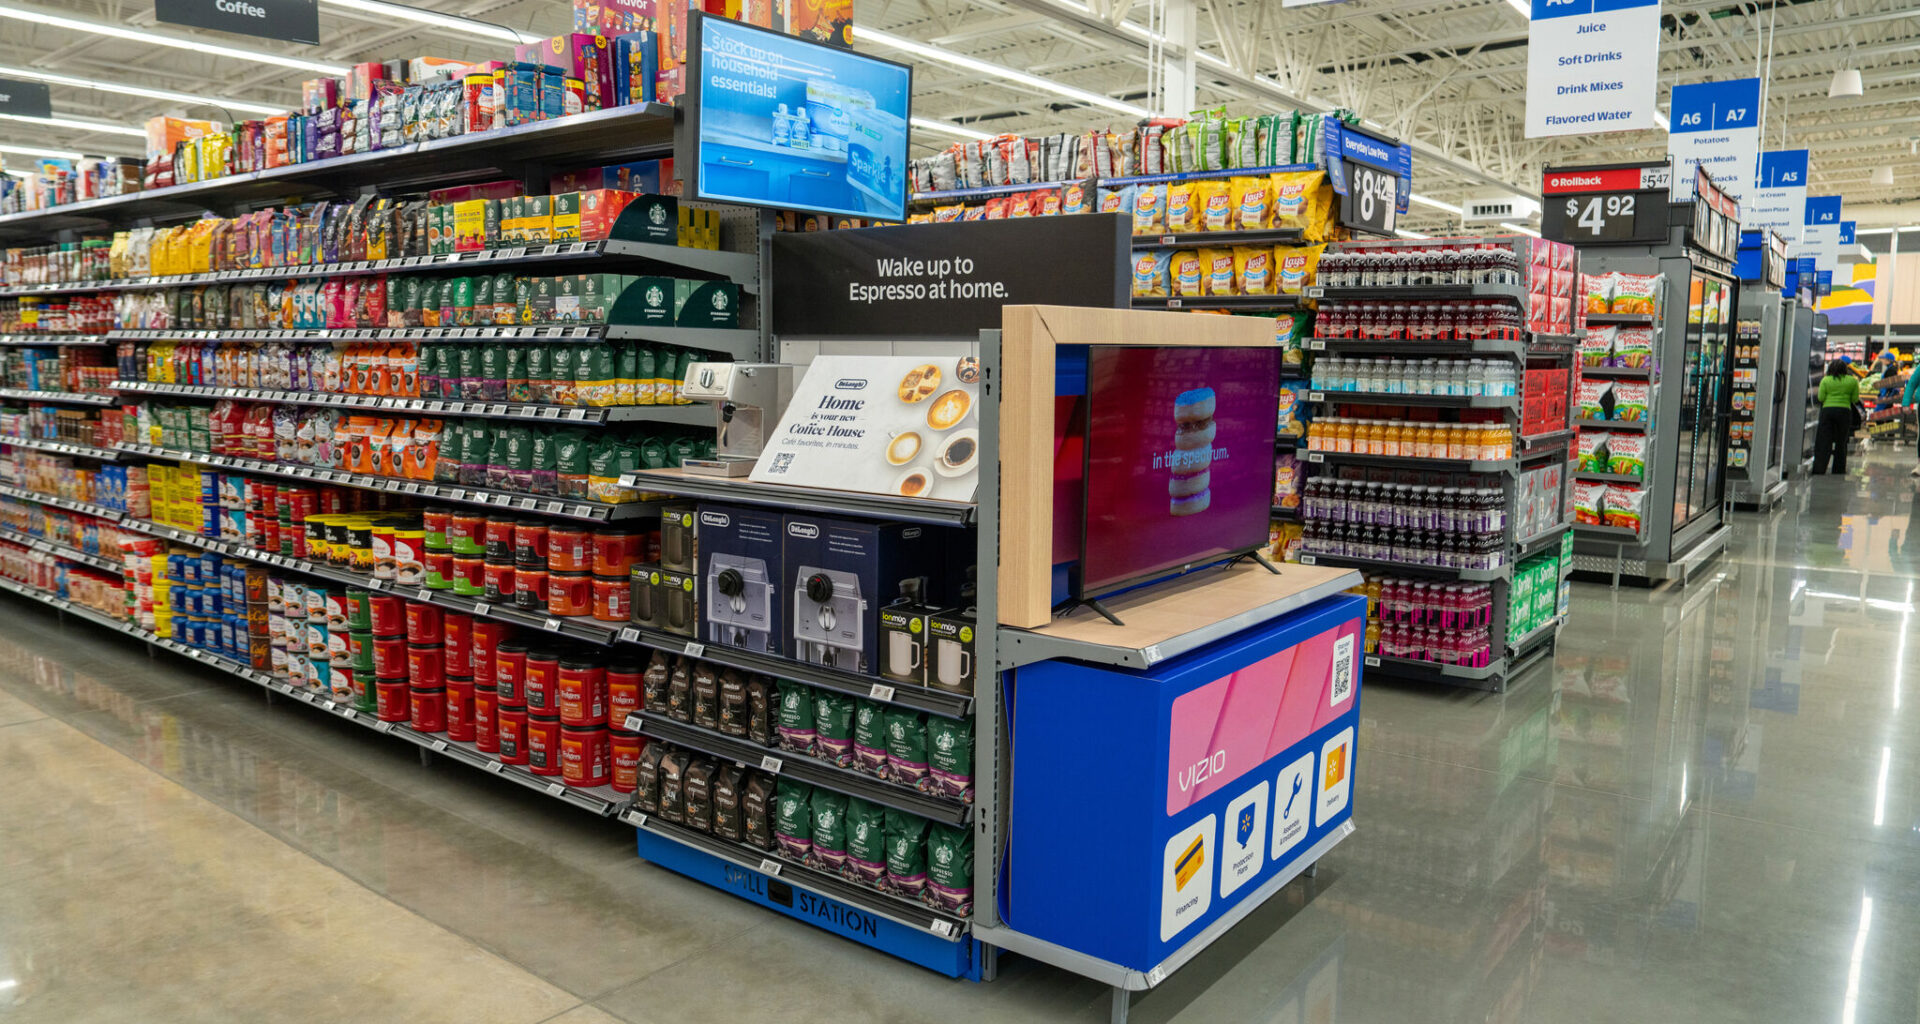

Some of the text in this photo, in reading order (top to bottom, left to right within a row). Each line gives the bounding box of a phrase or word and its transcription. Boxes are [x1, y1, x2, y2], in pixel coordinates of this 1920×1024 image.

[216, 0, 266, 18] Coffee
[1577, 23, 1606, 34] Juice
[712, 34, 783, 64] Stock up on
[1558, 52, 1622, 66] Soft Drinks
[712, 55, 778, 81] household
[711, 74, 777, 99] essentials!
[1557, 82, 1624, 95] Drink Mixes
[1546, 110, 1632, 125] Flavored Water
[1680, 112, 1702, 126] A6
[1726, 108, 1746, 122] A7
[1694, 136, 1730, 144] Potatoes
[1345, 137, 1388, 161] Everyday Low Price
[851, 151, 886, 184] Sparkle
[1714, 156, 1737, 164] Meals
[1560, 176, 1602, 186] Rollback
[1782, 172, 1798, 182] A5
[1820, 213, 1834, 221] A3
[877, 256, 974, 280] Wake up to
[850, 280, 1009, 304] Espresso at home.
[818, 395, 865, 411] Home
[810, 412, 818, 420] is
[790, 422, 865, 438] Coffee House
[797, 440, 824, 448] favorites,
[1153, 447, 1230, 470] in the spectrum.
[1539, 564, 1555, 585] Sprite
[1517, 576, 1531, 596] Sprite
[882, 611, 906, 625] ionmug
[931, 619, 956, 634] ionmug
[612, 696, 634, 704] Folgers
[1179, 750, 1226, 792] VIZIO
[1326, 794, 1340, 807] Delivery
[1232, 852, 1254, 871] Protection
[1237, 864, 1248, 877] Plans
[724, 864, 763, 896] SPILL
[1175, 896, 1199, 917] Financing
[800, 893, 877, 939] STATION
